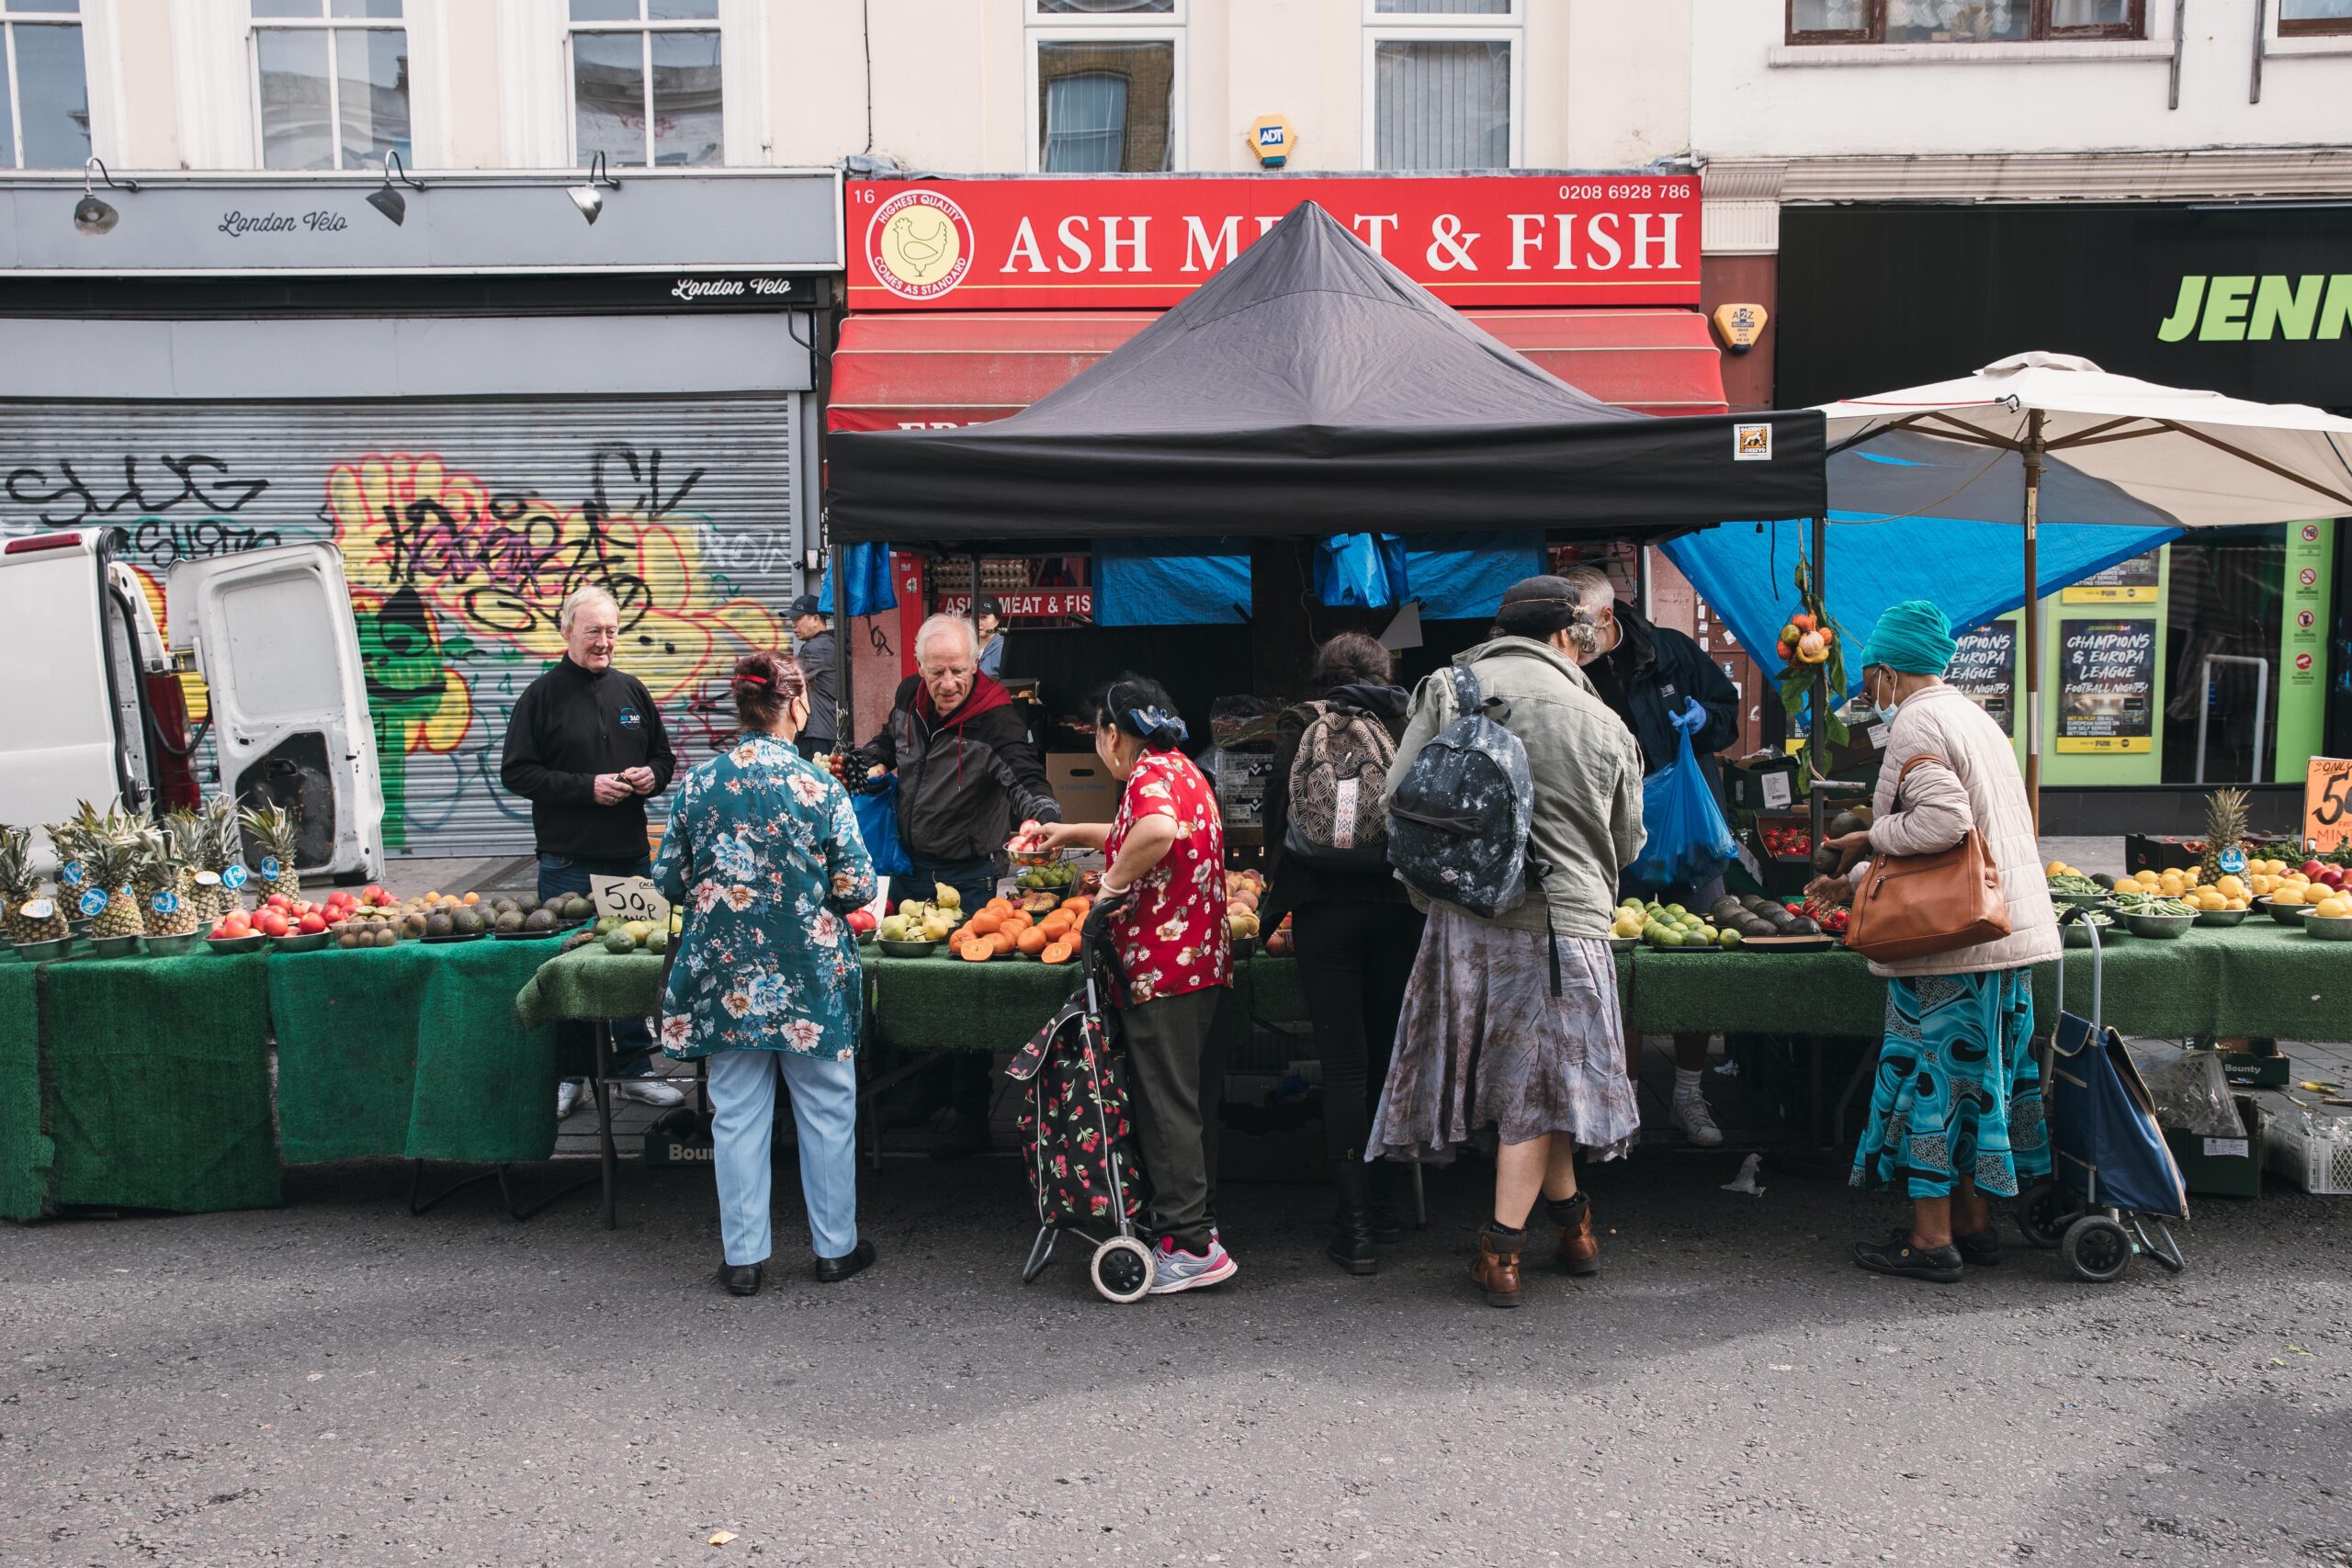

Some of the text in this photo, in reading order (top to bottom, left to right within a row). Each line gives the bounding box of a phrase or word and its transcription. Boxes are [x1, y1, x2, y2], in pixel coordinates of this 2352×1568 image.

[1261, 129, 1283, 143] ADT
[854, 189, 875, 204] 16
[1559, 185, 1690, 199] 0208 6928 786
[877, 195, 962, 224] HIGHEST QUALITY
[218, 210, 348, 237] London Velo
[999, 212, 1683, 273] ASH MT & FISH
[874, 256, 967, 295] COMES AS STANDARD
[671, 278, 792, 301] London Velo
[999, 597, 1042, 613] MEAT
[1048, 597, 1058, 613] &
[1956, 633, 2011, 651] MPIONS
[2066, 633, 2150, 650] CHAMPIONS
[2072, 649, 2145, 664] & EUROPA
[2079, 665, 2137, 681] LEAGUE
[2064, 682, 2149, 694] FOOTBALL NIGHTS!
[2224, 1064, 2261, 1075] Bounty
